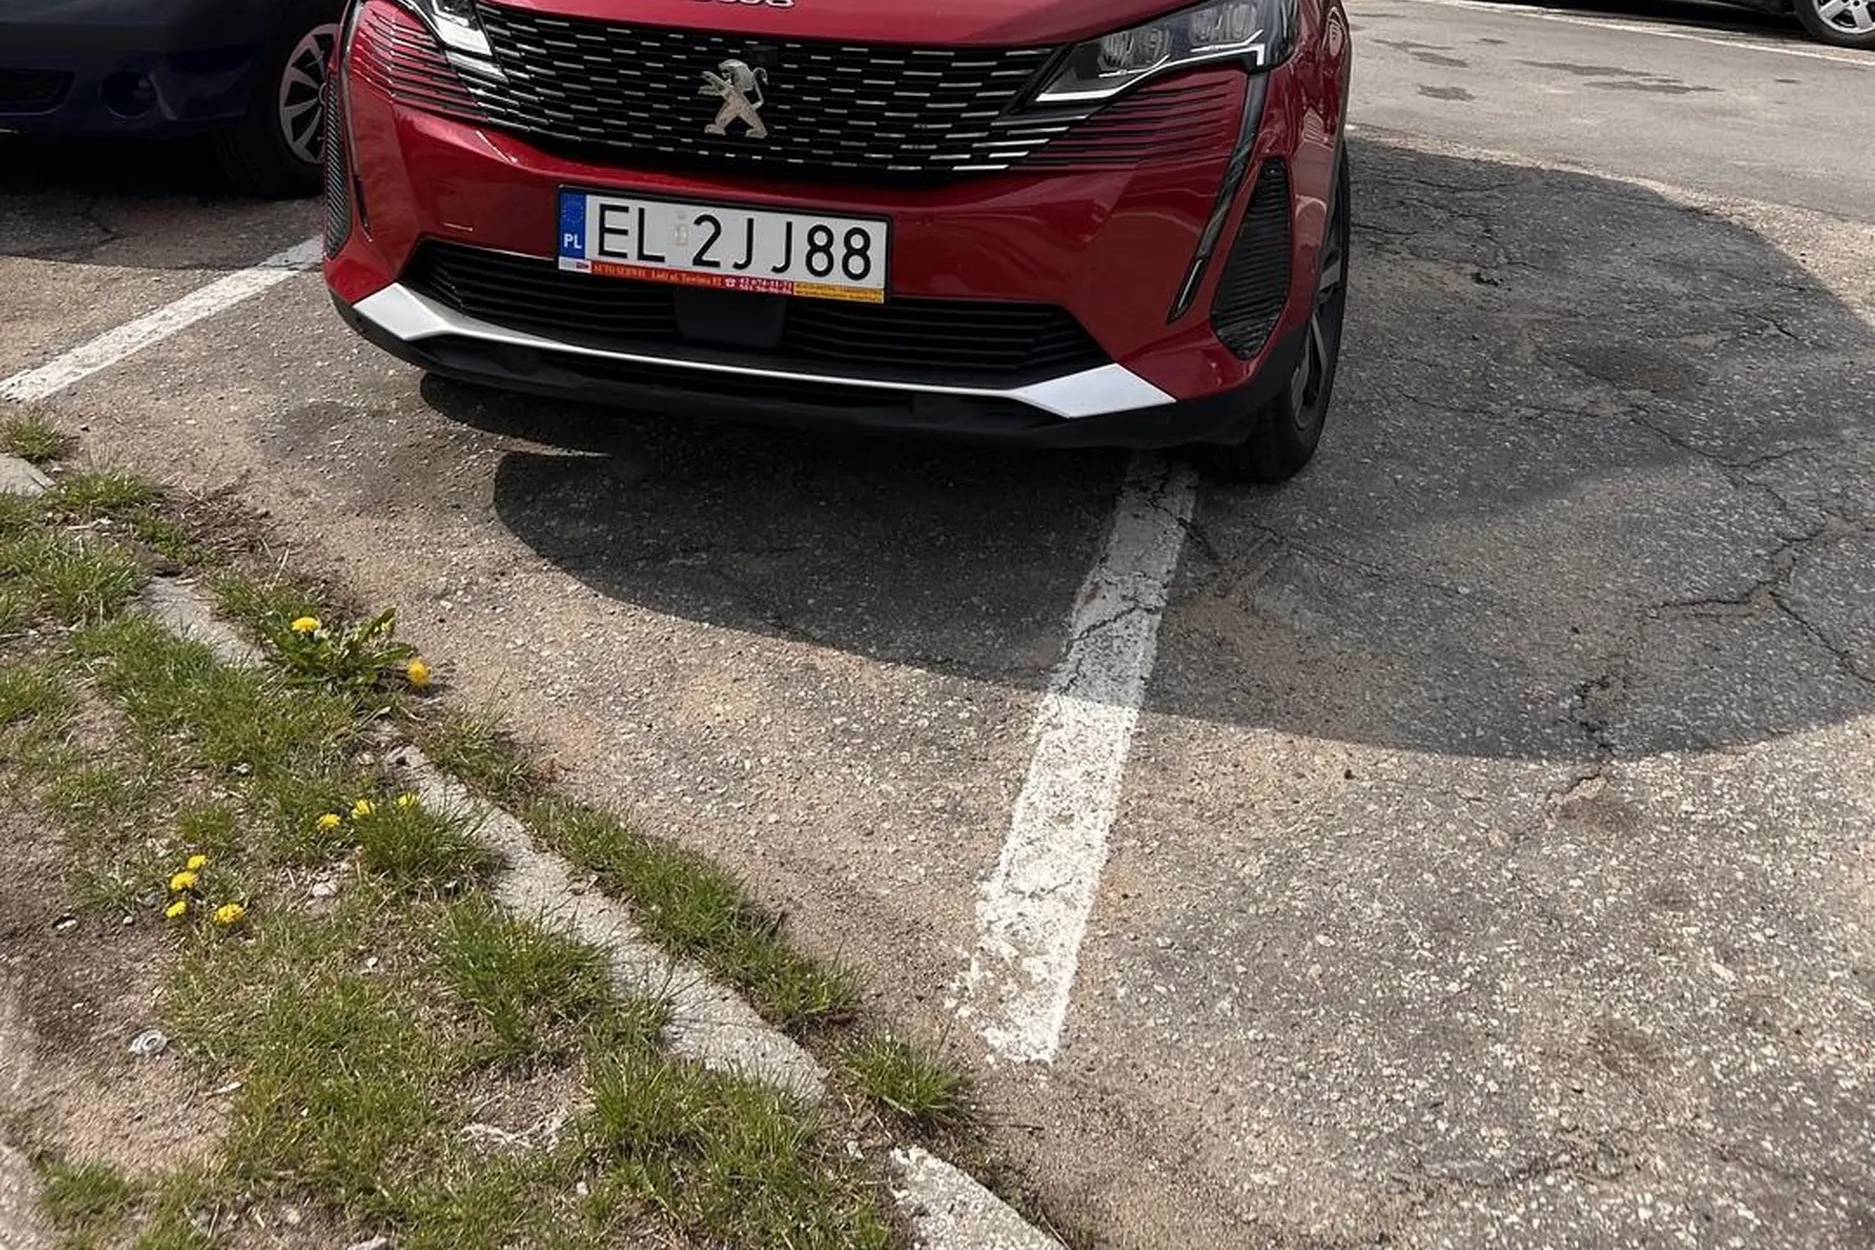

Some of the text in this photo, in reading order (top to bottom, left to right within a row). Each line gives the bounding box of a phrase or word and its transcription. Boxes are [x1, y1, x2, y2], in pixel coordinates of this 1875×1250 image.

[563, 233, 582, 250] PL
[598, 203, 871, 281] EL 2JJ88
